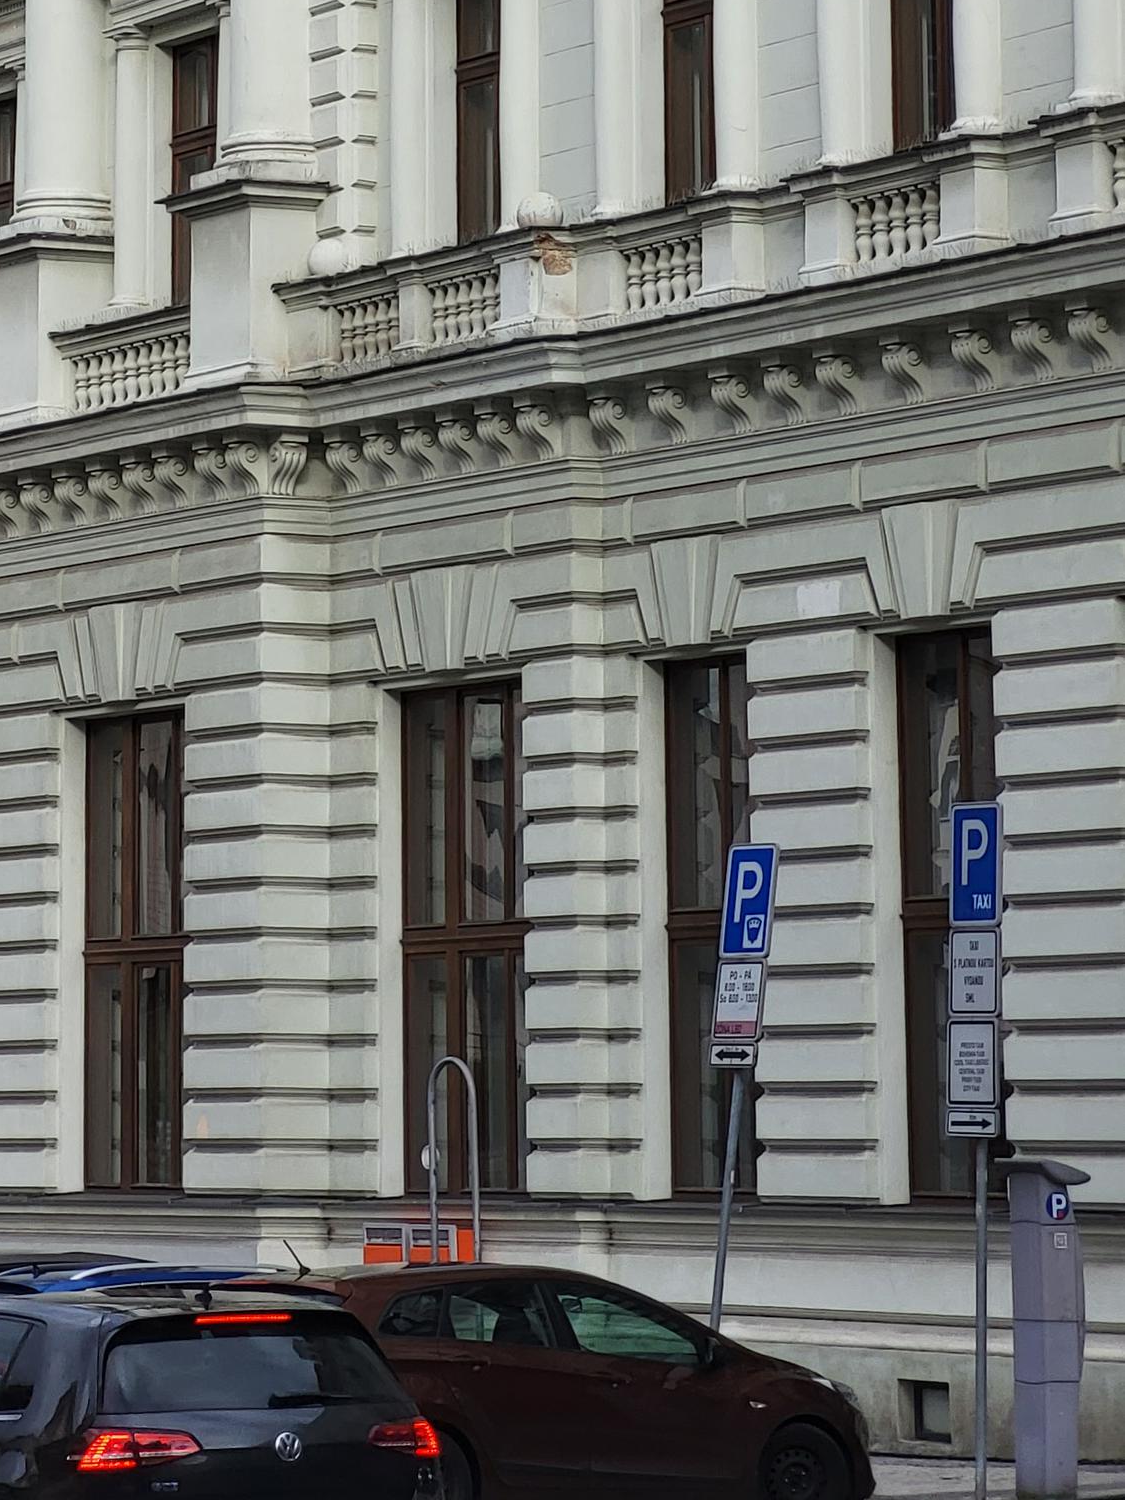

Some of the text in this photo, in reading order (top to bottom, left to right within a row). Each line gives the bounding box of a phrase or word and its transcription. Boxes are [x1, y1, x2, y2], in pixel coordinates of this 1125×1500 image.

[961, 819, 989, 886] P
[733, 861, 764, 924] P
[972, 893, 992, 910] TAXI
[1052, 1193, 1067, 1218] P
